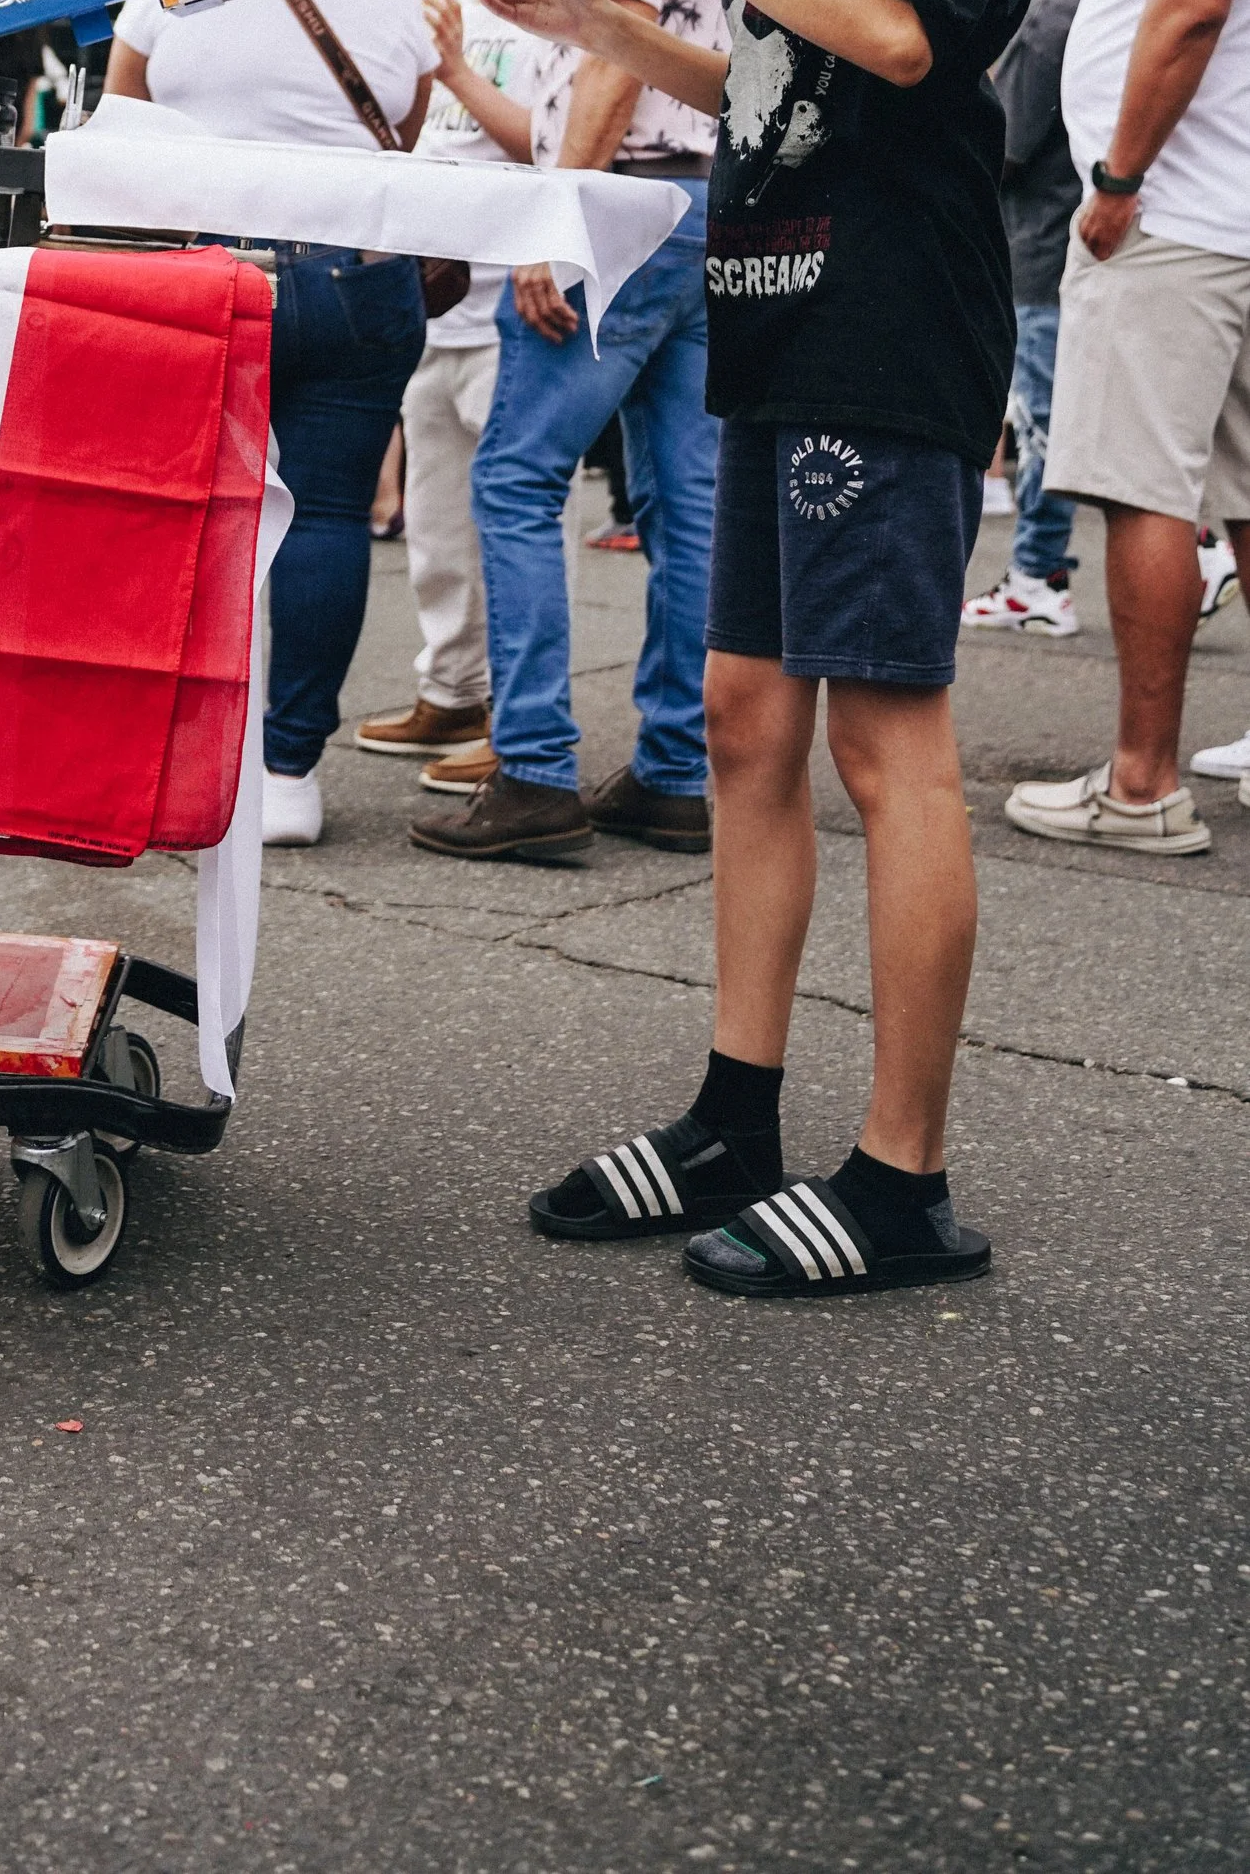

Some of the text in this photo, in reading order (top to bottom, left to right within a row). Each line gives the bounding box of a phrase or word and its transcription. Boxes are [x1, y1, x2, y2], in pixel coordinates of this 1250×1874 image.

[814, 71, 832, 95] YOU
[705, 250, 825, 300] SCREAMS
[791, 434, 864, 468] OLD NAVY
[789, 478, 865, 521] CALIFORNIA
